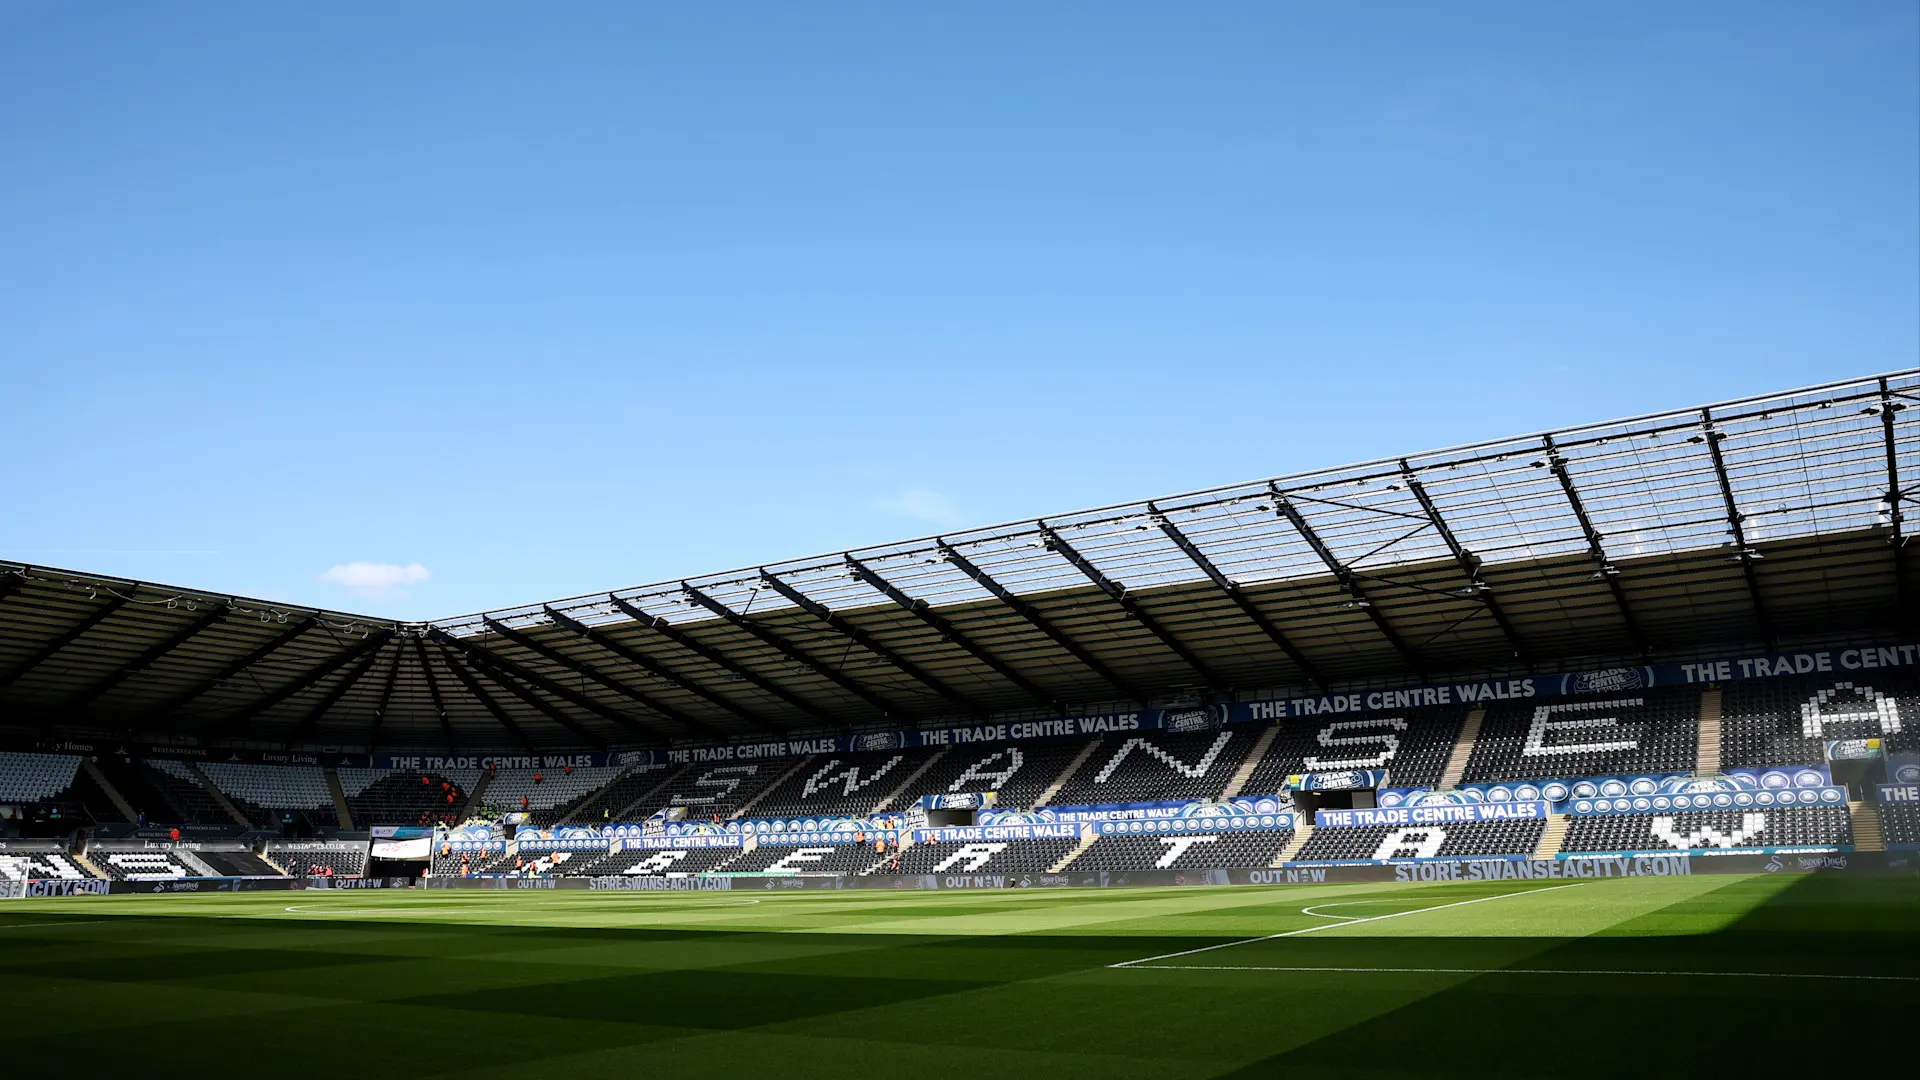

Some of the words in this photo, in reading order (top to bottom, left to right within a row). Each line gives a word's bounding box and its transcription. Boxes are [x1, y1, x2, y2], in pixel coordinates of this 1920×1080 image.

[1681, 661, 1731, 683] THE
[1737, 652, 1833, 678] TRADE
[1840, 645, 1920, 669] CENT
[1583, 668, 1628, 681] TRADE
[1589, 674, 1626, 689] CENTRE
[1249, 702, 1286, 719] THE
[1292, 694, 1361, 715] TRADE
[1367, 687, 1450, 710] CENTRE
[1456, 679, 1536, 702] WALES
[1175, 716, 1204, 728] CENTRE
[920, 730, 949, 746] THE
[952, 725, 1006, 743] TRADE
[1010, 719, 1074, 738] CENTRE
[1078, 714, 1139, 734] WALES
[667, 750, 689, 763] THE
[692, 747, 733, 761] TRADE
[737, 742, 786, 759] CENTRE
[789, 739, 836, 754] WALES
[262, 752, 289, 763] Luxury
[292, 754, 318, 765] Living
[390, 757, 420, 769] THE
[425, 757, 477, 769] TRADE
[481, 756, 540, 769] CENTRE
[543, 755, 592, 769] WALES
[1317, 771, 1355, 783] TRADE
[1322, 777, 1352, 790] CENTRE
[944, 793, 973, 802] TRADE
[1881, 787, 1919, 801] THE
[949, 799, 970, 809] CENTRE
[1059, 813, 1076, 822] THE
[1077, 811, 1108, 821] TRADE
[1109, 809, 1147, 820] CENTRE
[1148, 807, 1179, 818] WALES
[1322, 812, 1351, 826] THE
[1355, 809, 1408, 824] TRADE
[1411, 806, 1475, 823] CENTRE
[1478, 803, 1537, 819] WALES
[920, 829, 941, 841] THE
[943, 828, 982, 840] TRADE
[984, 826, 1030, 839] CENTRE
[1032, 824, 1075, 837] WALES
[144, 841, 173, 851] Luxury
[176, 841, 201, 851] Living
[626, 839, 641, 849] THE
[643, 838, 672, 848] TRADE
[673, 837, 706, 848] CENTRE
[708, 835, 740, 847] WALES
[1395, 856, 1691, 881] STORE.SWANSEACITY.COM
[945, 876, 971, 888] OUT
[1250, 869, 1283, 884] OUT
[335, 880, 357, 888] OUT
[518, 880, 535, 888] OUT
[589, 877, 732, 891] STORE.SWANSEACITY.COM
